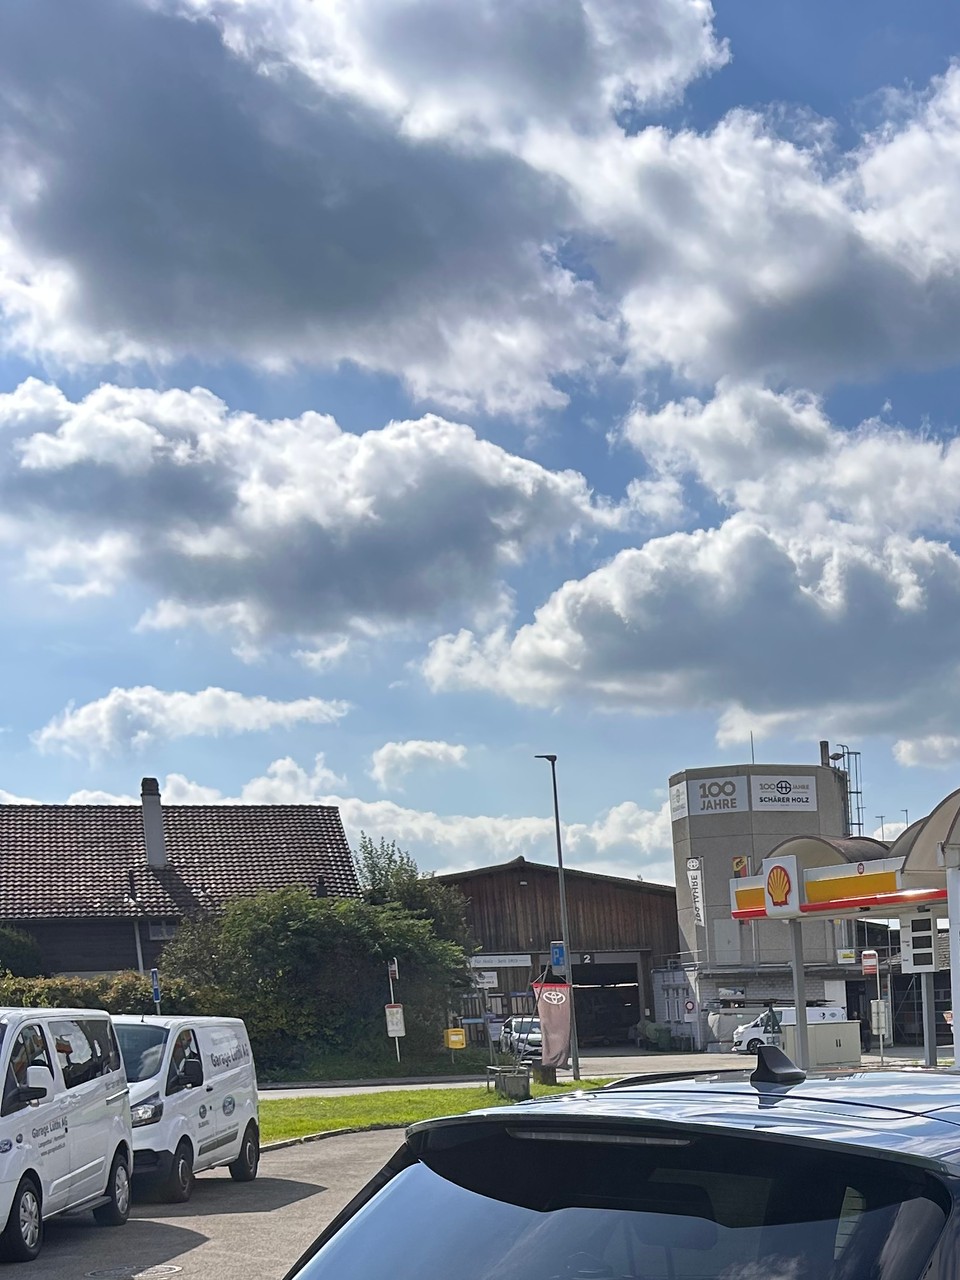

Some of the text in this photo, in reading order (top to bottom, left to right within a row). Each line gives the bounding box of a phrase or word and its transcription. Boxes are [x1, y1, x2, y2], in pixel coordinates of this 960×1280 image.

[699, 780, 736, 798] 100
[700, 798, 738, 811] JAHRE
[759, 795, 791, 803] SCHÄRER
[583, 954, 591, 964] 2
